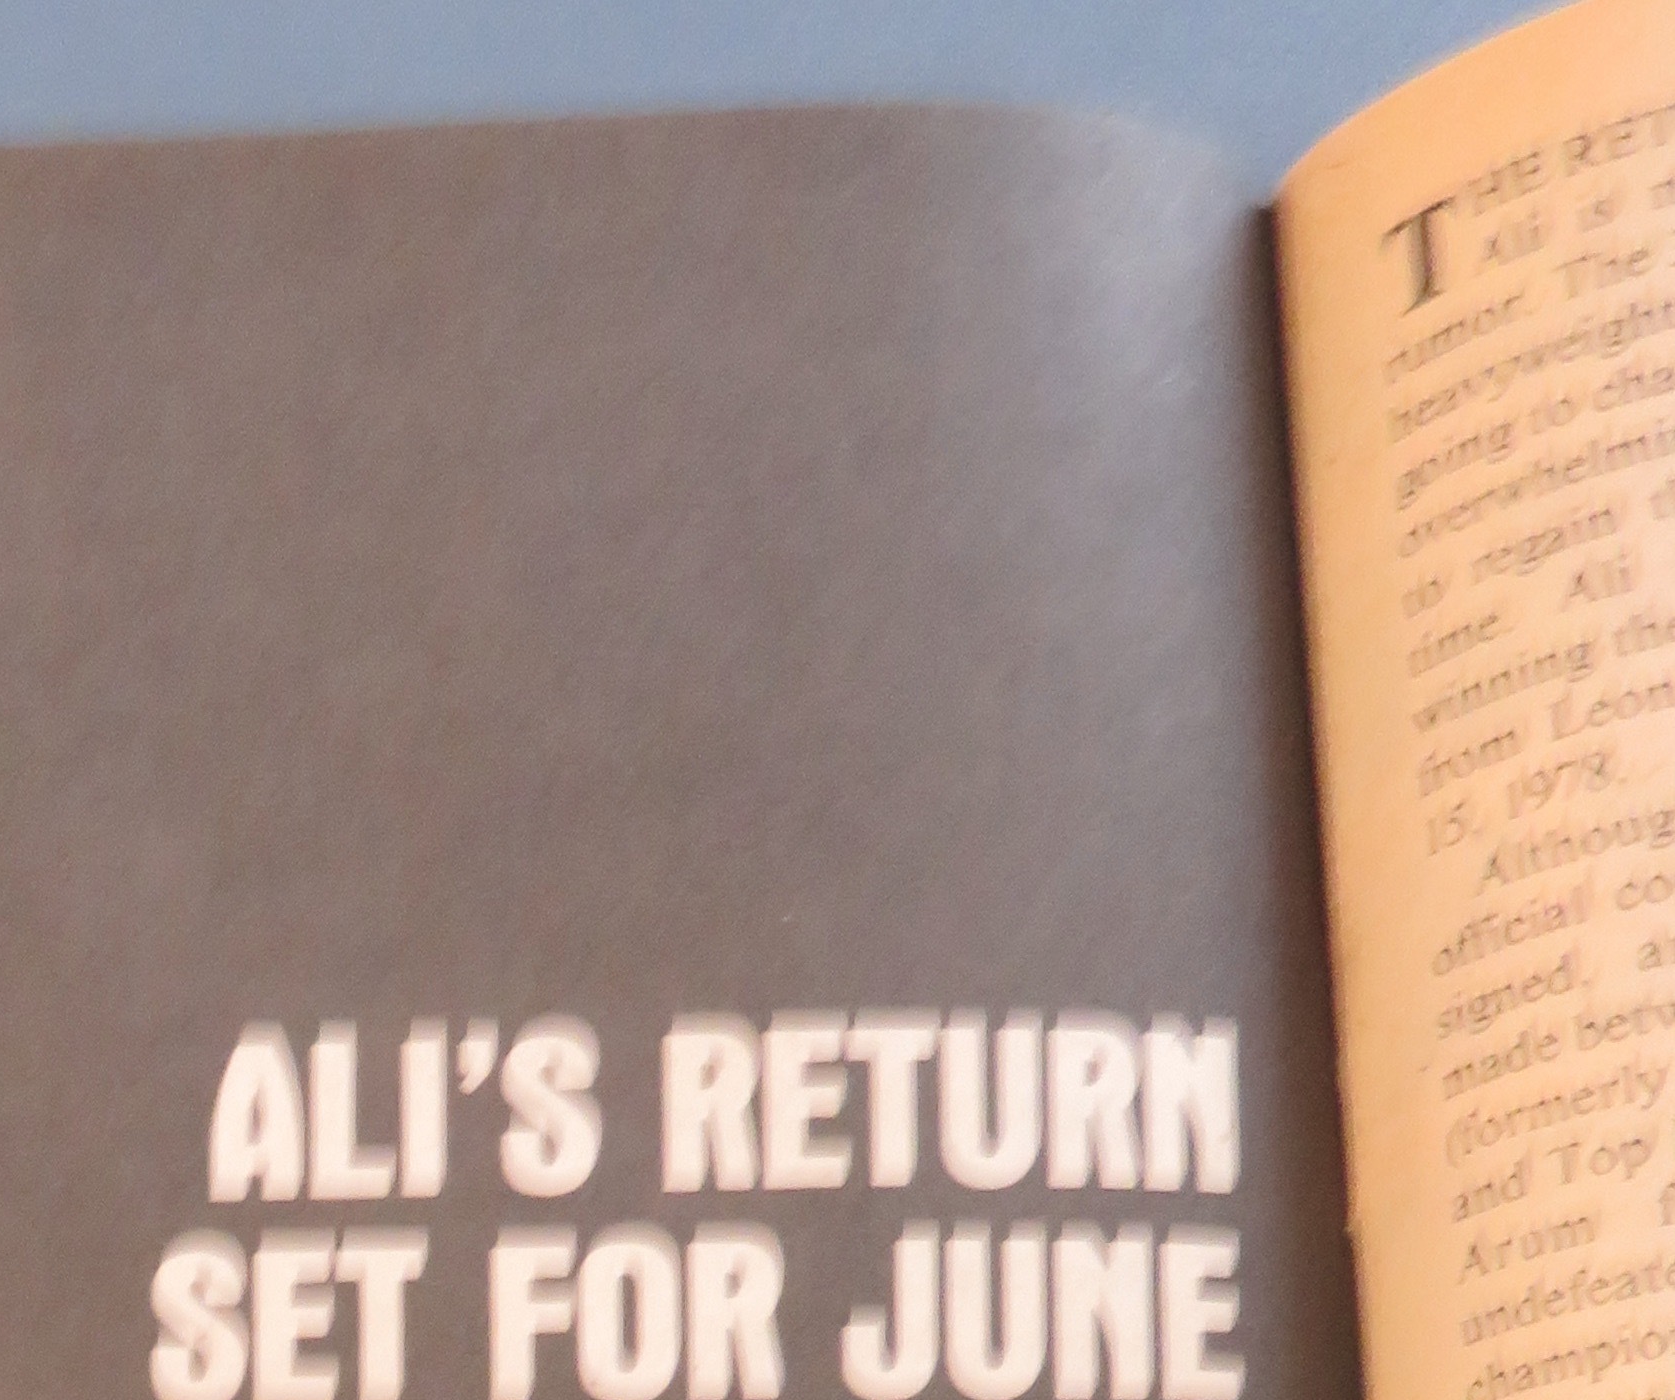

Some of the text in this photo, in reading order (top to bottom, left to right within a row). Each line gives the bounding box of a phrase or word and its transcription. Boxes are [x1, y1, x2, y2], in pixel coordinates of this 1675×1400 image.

[1396, 422, 1511, 511] going
[1526, 397, 1574, 435] to
[1401, 576, 1446, 618] to
[1471, 507, 1620, 585] regain
[1566, 551, 1639, 611] Ali
[1413, 641, 1592, 734] winning
[1419, 727, 1523, 797] from
[1431, 886, 1588, 977] official
[208, 1007, 1240, 1202] ALI'S RETURN
[1442, 1029, 1563, 1100] made
[1445, 1065, 1669, 1169] (formerly
[1452, 1137, 1652, 1222] and Top
[1457, 1215, 1596, 1285] Arum
